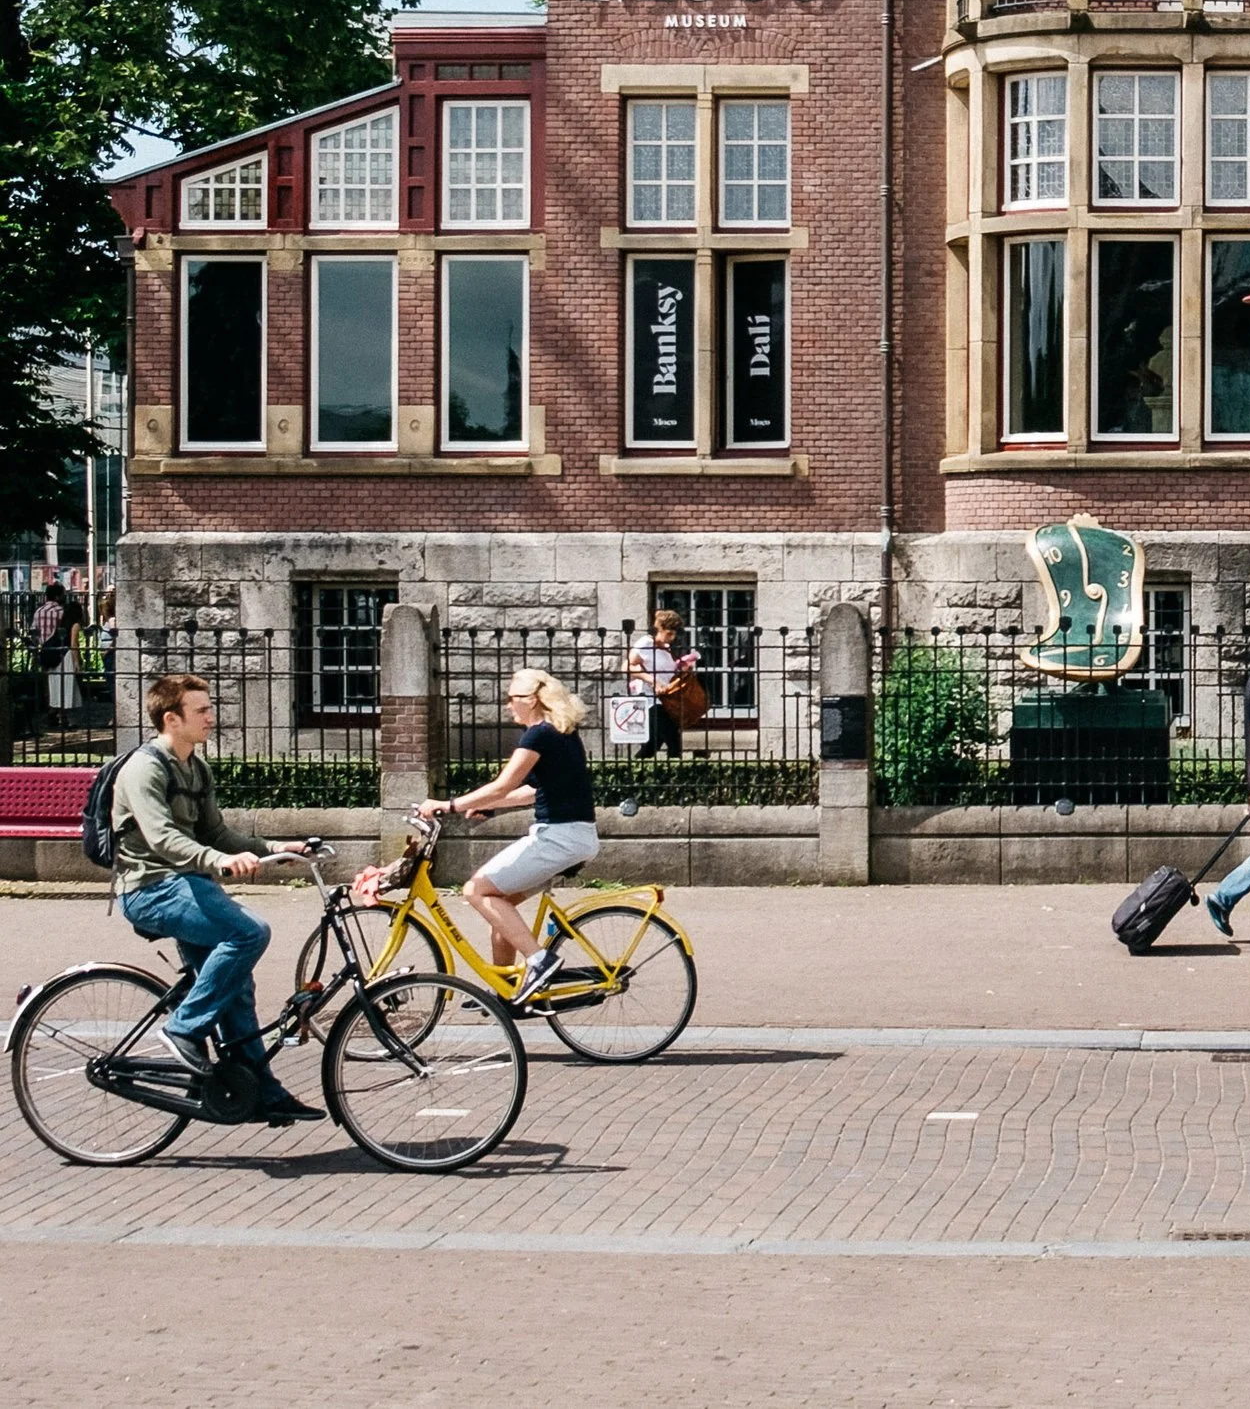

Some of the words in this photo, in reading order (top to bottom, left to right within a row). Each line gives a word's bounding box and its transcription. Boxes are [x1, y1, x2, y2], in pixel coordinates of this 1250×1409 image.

[664, 14, 748, 28] MUSEUM
[650, 282, 683, 396] Banksy
[747, 315, 771, 378] Dalí
[653, 418, 678, 426] Moco
[750, 418, 771, 427] Moco
[1044, 546, 1063, 565] 10
[1122, 544, 1133, 557] 2
[1117, 570, 1129, 588] 3
[1060, 589, 1072, 608] 9
